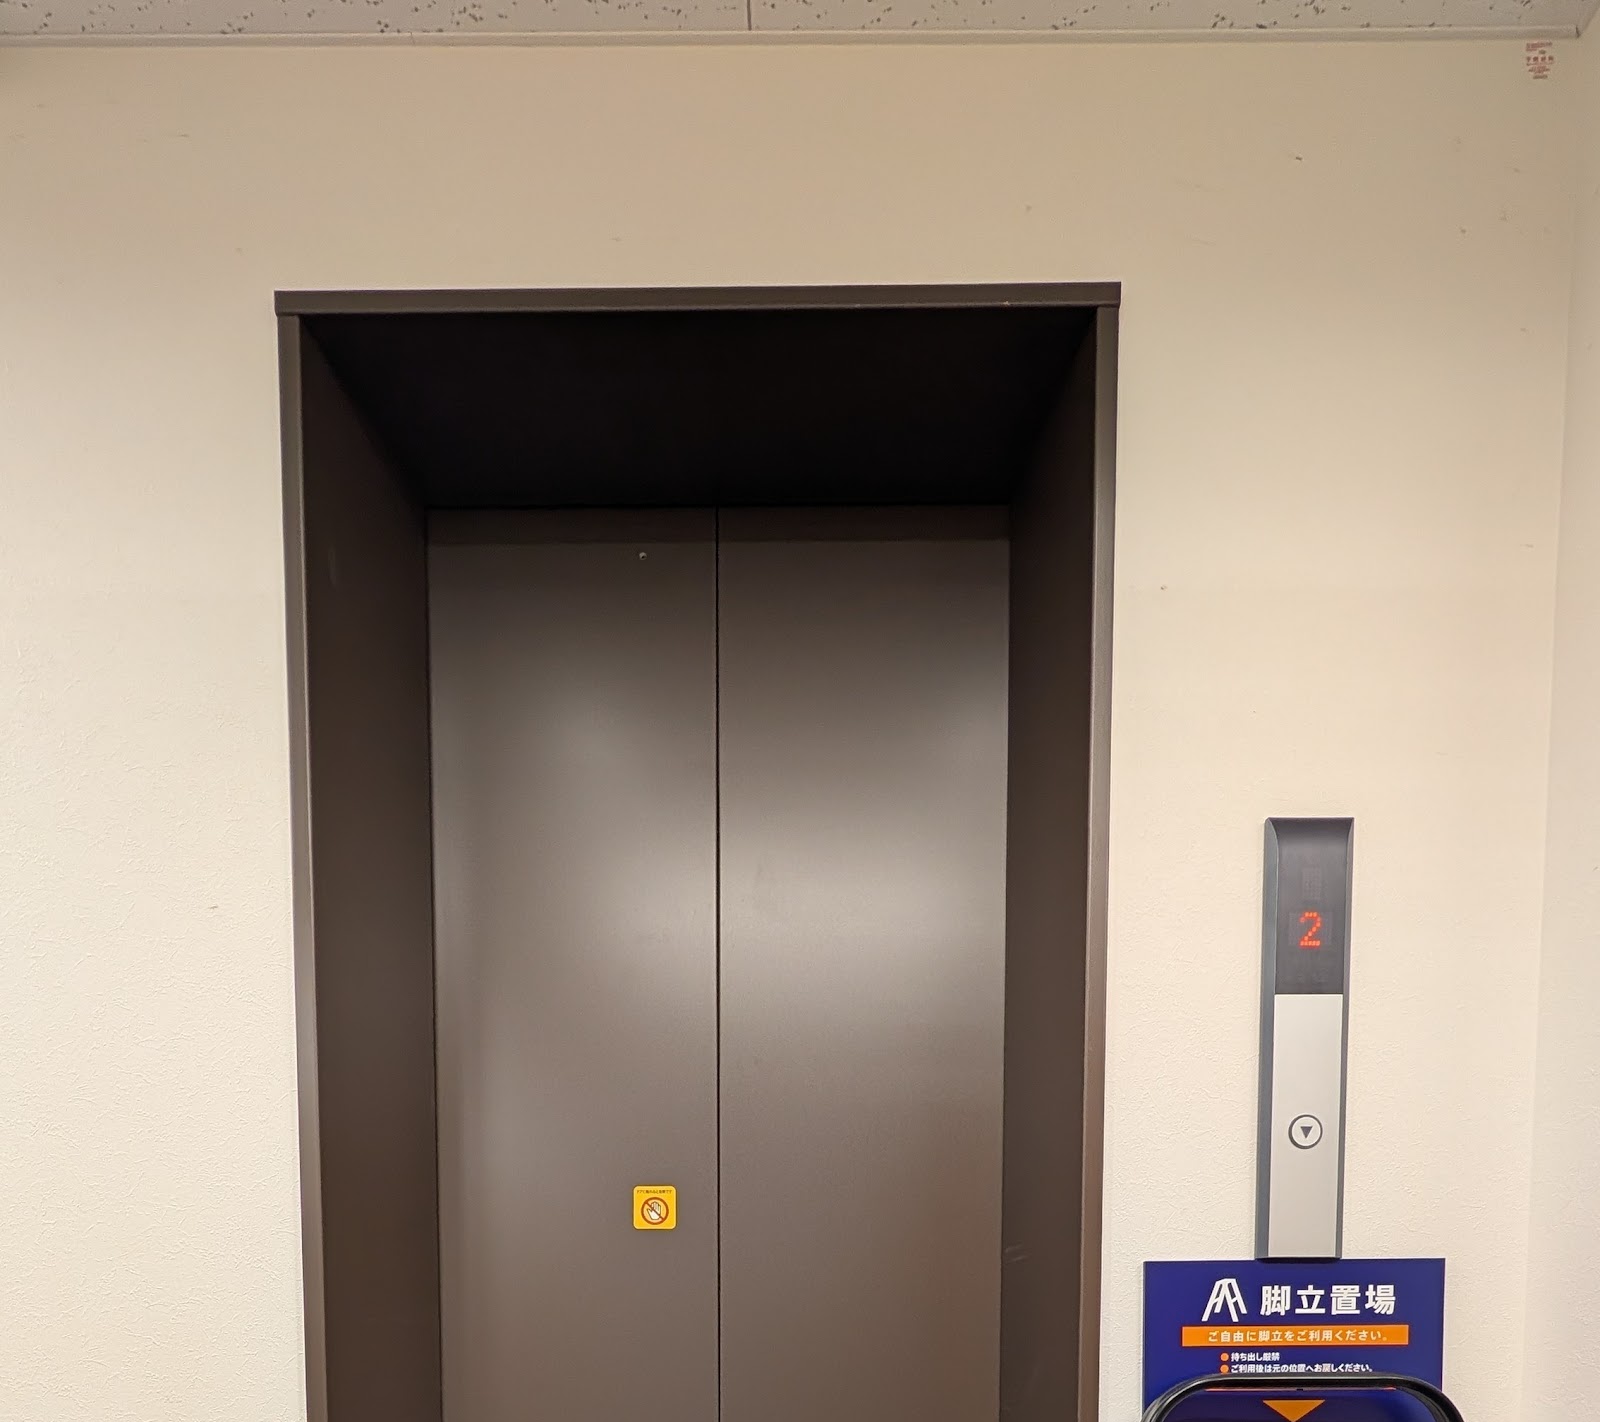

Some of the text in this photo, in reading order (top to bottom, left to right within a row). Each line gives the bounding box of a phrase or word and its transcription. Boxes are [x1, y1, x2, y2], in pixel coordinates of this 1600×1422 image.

[1300, 911, 1321, 947] 2
[1260, 1285, 1396, 1316] 脚立置場
[1208, 1329, 1388, 1342] ご自由に脚立をご利用ください。
[1230, 1352, 1280, 1362] 持ち出し厳禁
[1230, 1363, 1373, 1373] ご利用後は元の位置へお戻しください。
